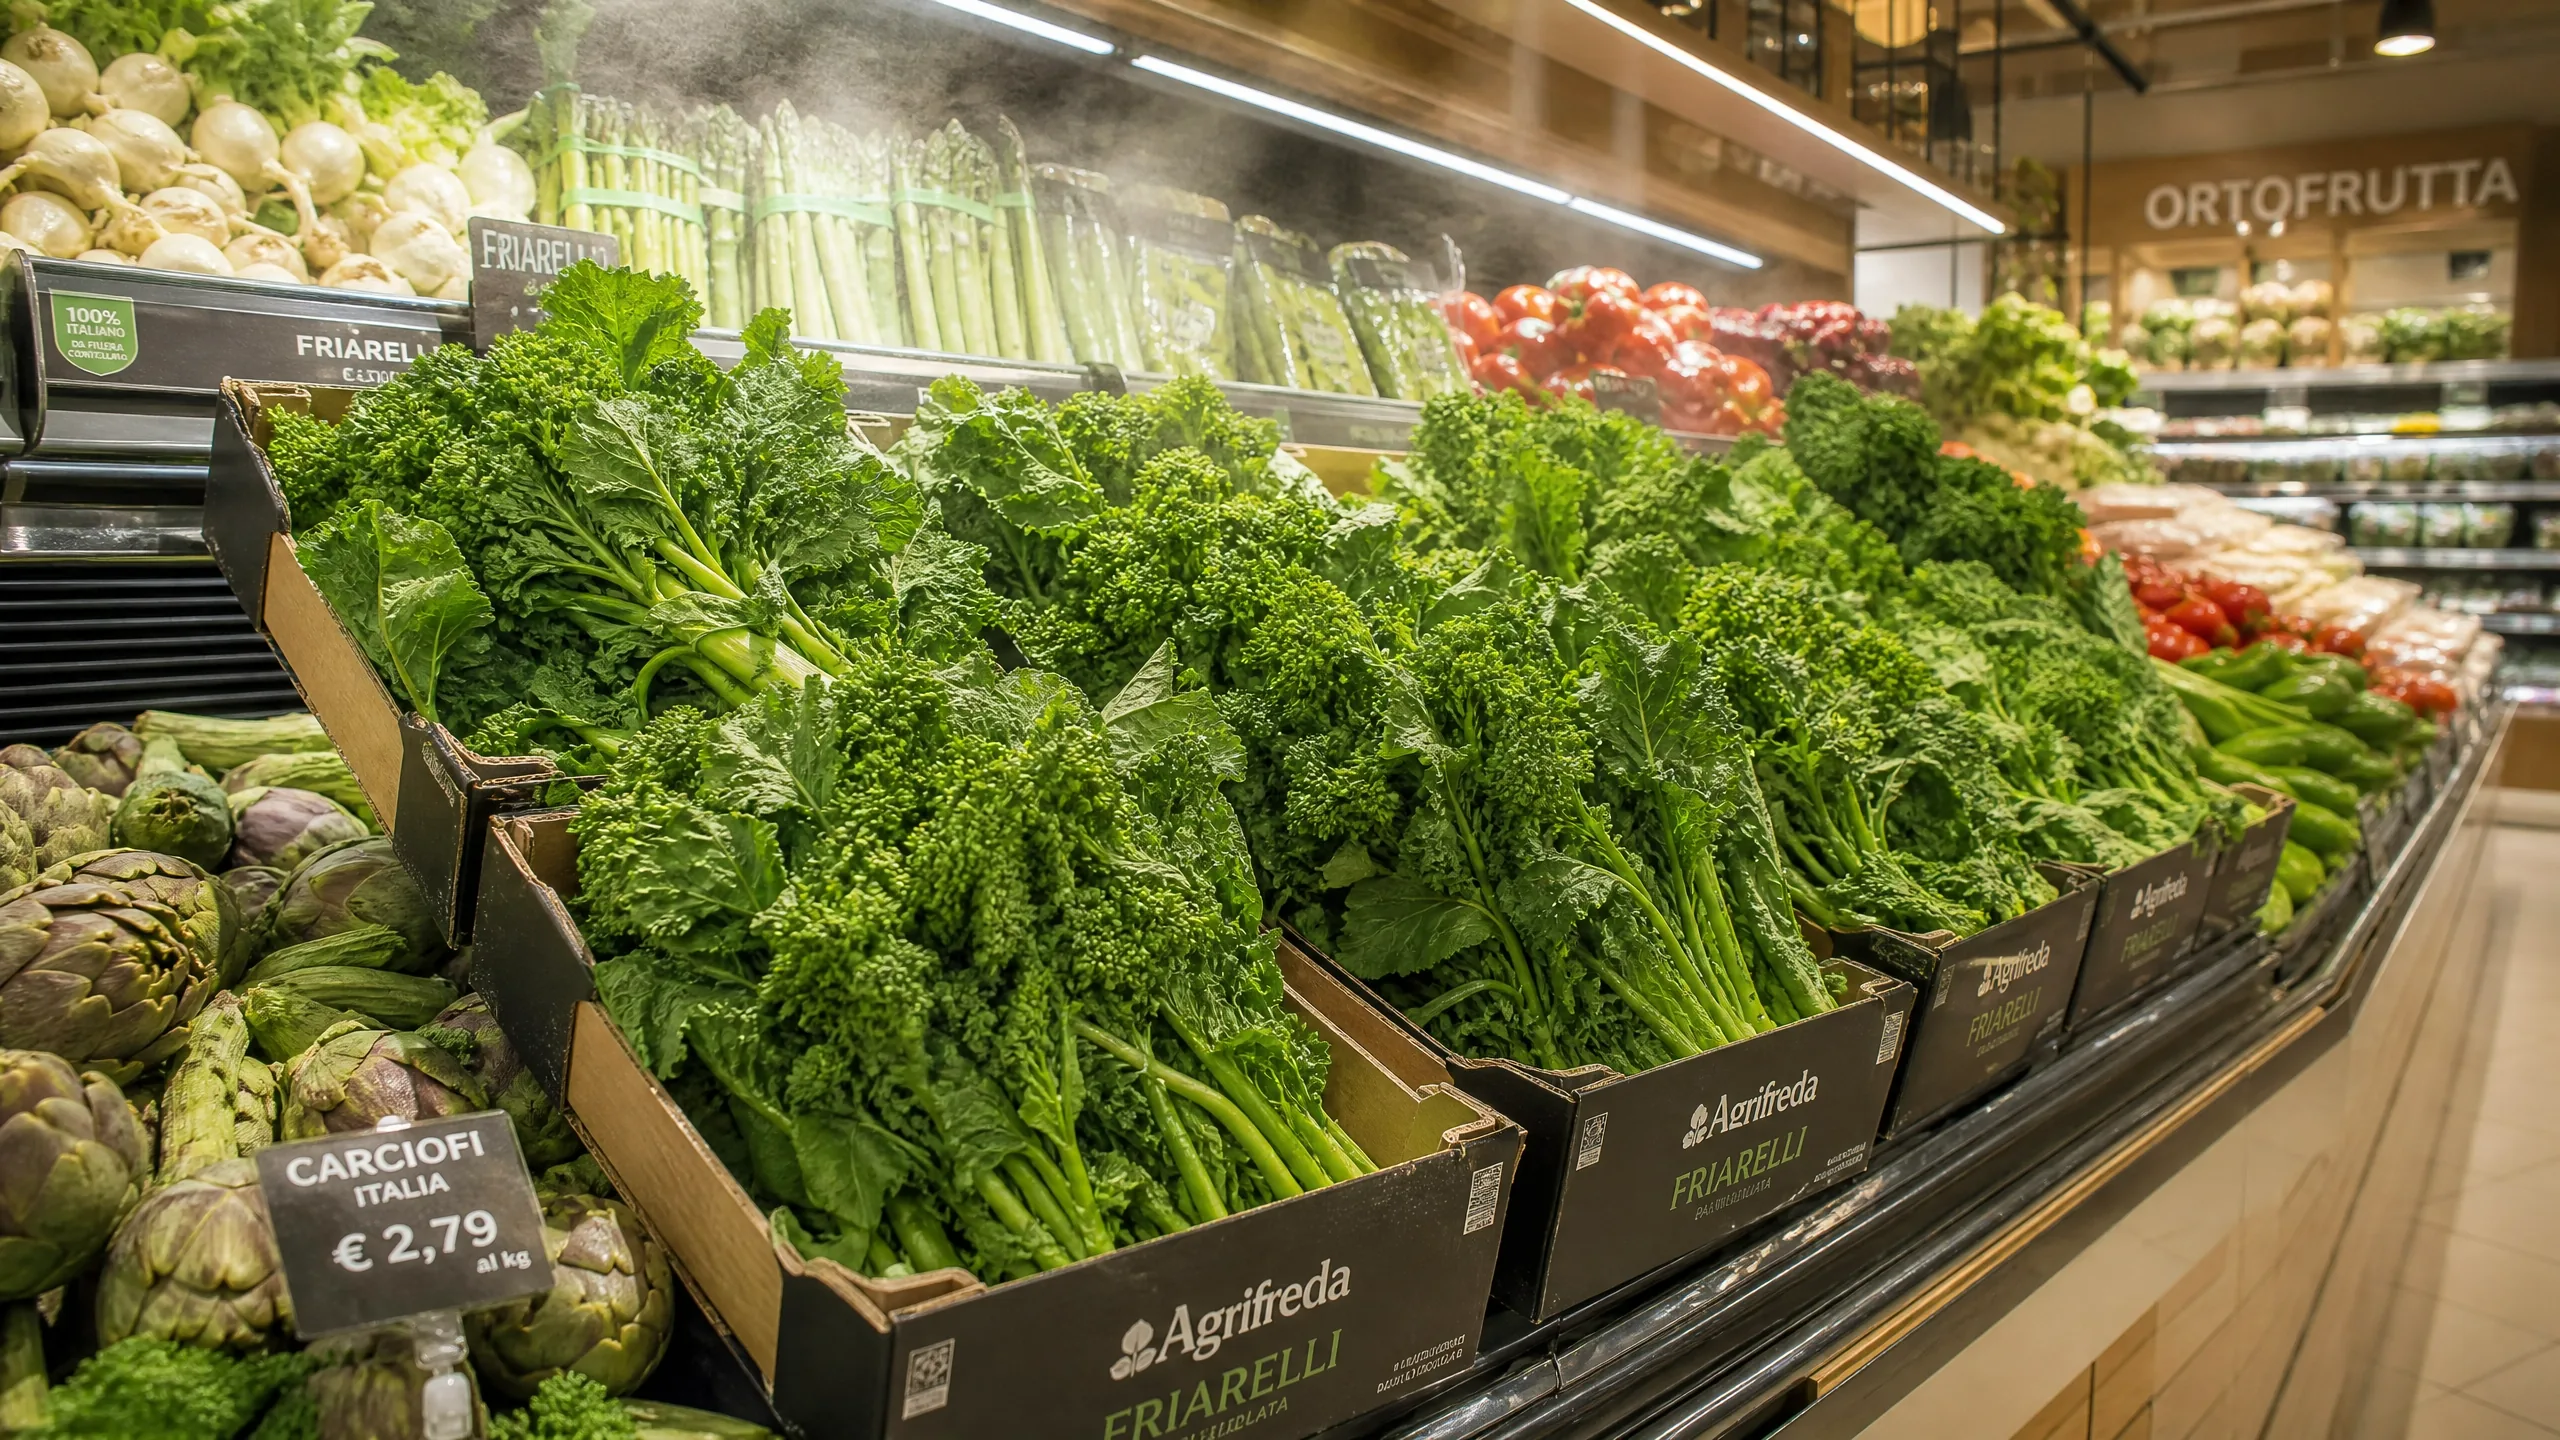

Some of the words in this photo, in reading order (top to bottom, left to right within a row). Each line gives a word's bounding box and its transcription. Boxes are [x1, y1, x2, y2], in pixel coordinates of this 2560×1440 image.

[2144, 157, 2519, 230] ORTOFRUTTA
[66, 307, 121, 325] 100%
[66, 323, 125, 338] ITALIANO
[1990, 940, 2050, 993] Agrifreda
[1966, 986, 2042, 1047] FRIARELLI
[1706, 1069, 1819, 1138] Agrifreda
[286, 1130, 484, 1187] CARCIOFI
[1669, 1125, 1808, 1211] FRIARELLI
[354, 1172, 450, 1207] ITALIA
[332, 1233, 373, 1272] €
[382, 1210, 498, 1265] 2,79
[477, 1253, 497, 1273] al
[502, 1250, 531, 1270] kg
[1155, 1258, 1351, 1364] Agrifreda
[1103, 1328, 1342, 1440] FRIARELLI
